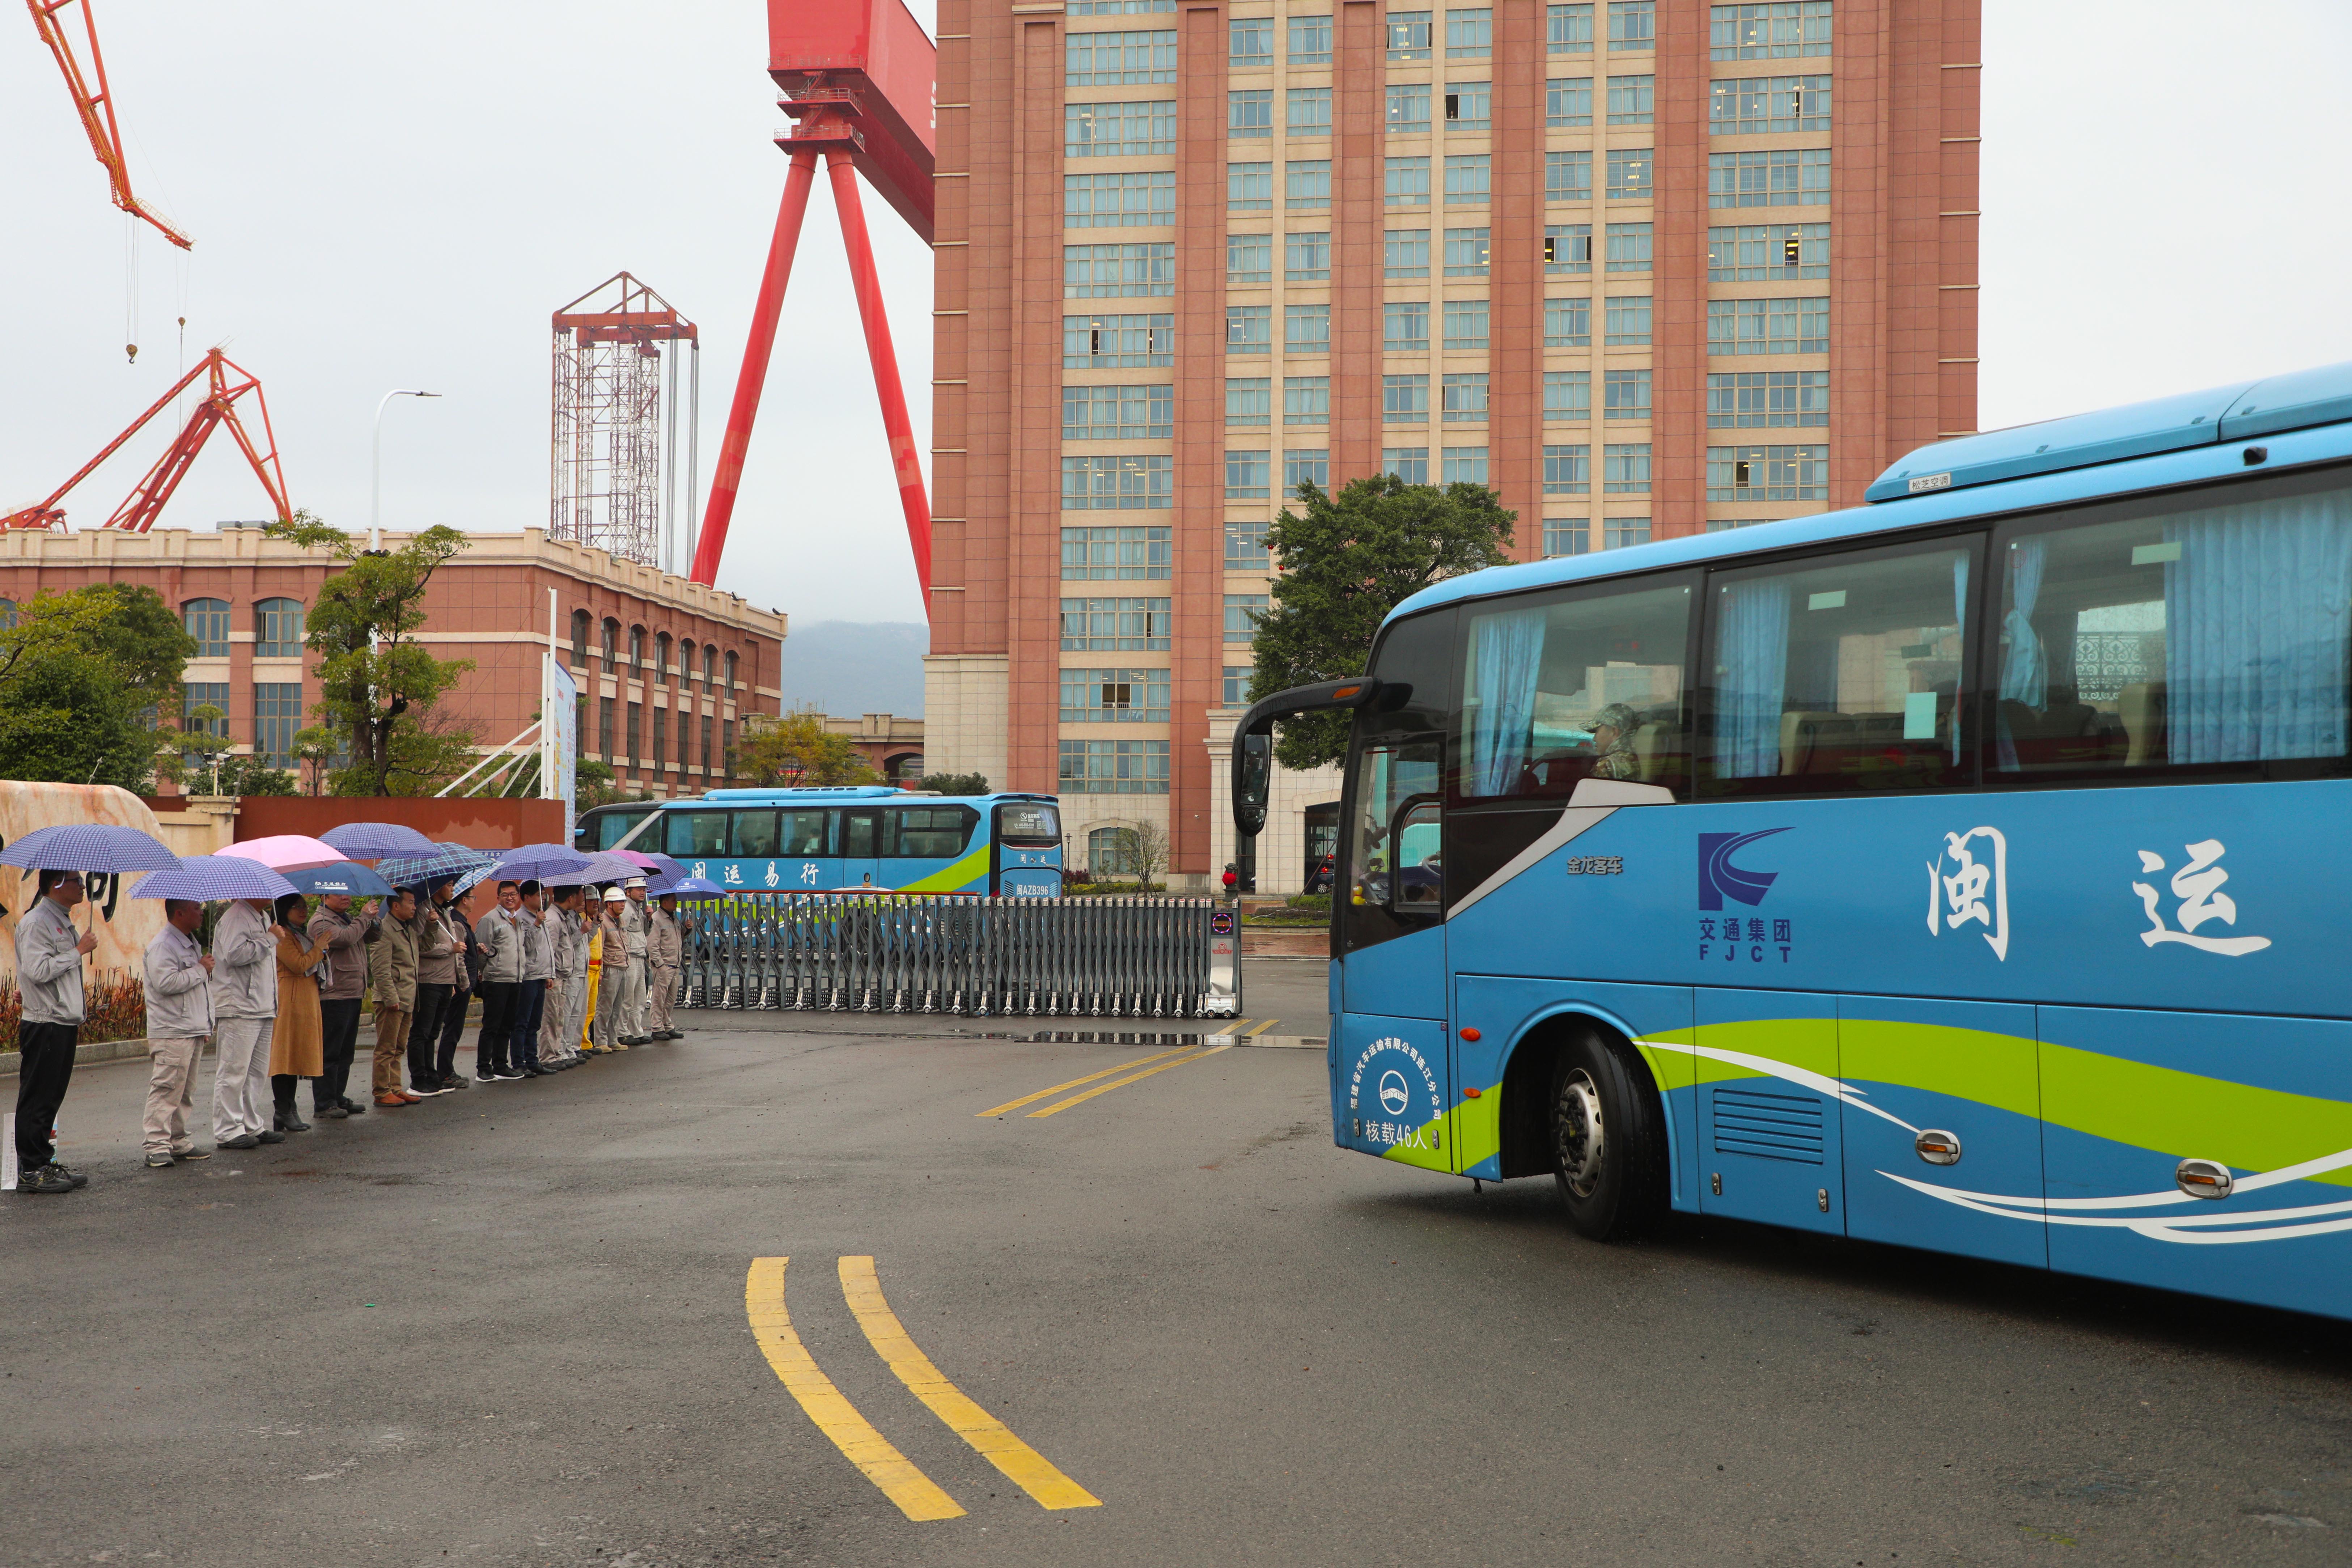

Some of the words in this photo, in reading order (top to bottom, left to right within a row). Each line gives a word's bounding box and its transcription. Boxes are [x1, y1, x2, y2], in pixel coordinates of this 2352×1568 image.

[1911, 476, 1948, 491] 松芝空调
[1567, 856, 1623, 874] 金龙客车
[1017, 884, 1048, 896] 闽AZB396
[1927, 826, 2271, 962] 闽运
[1699, 918, 1791, 943] 交通集团
[1699, 944, 1791, 963] FJCT
[1350, 1037, 1442, 1120] 福建省汽车运输有限公司连江分公司
[1365, 1120, 1427, 1150] 核载46人
